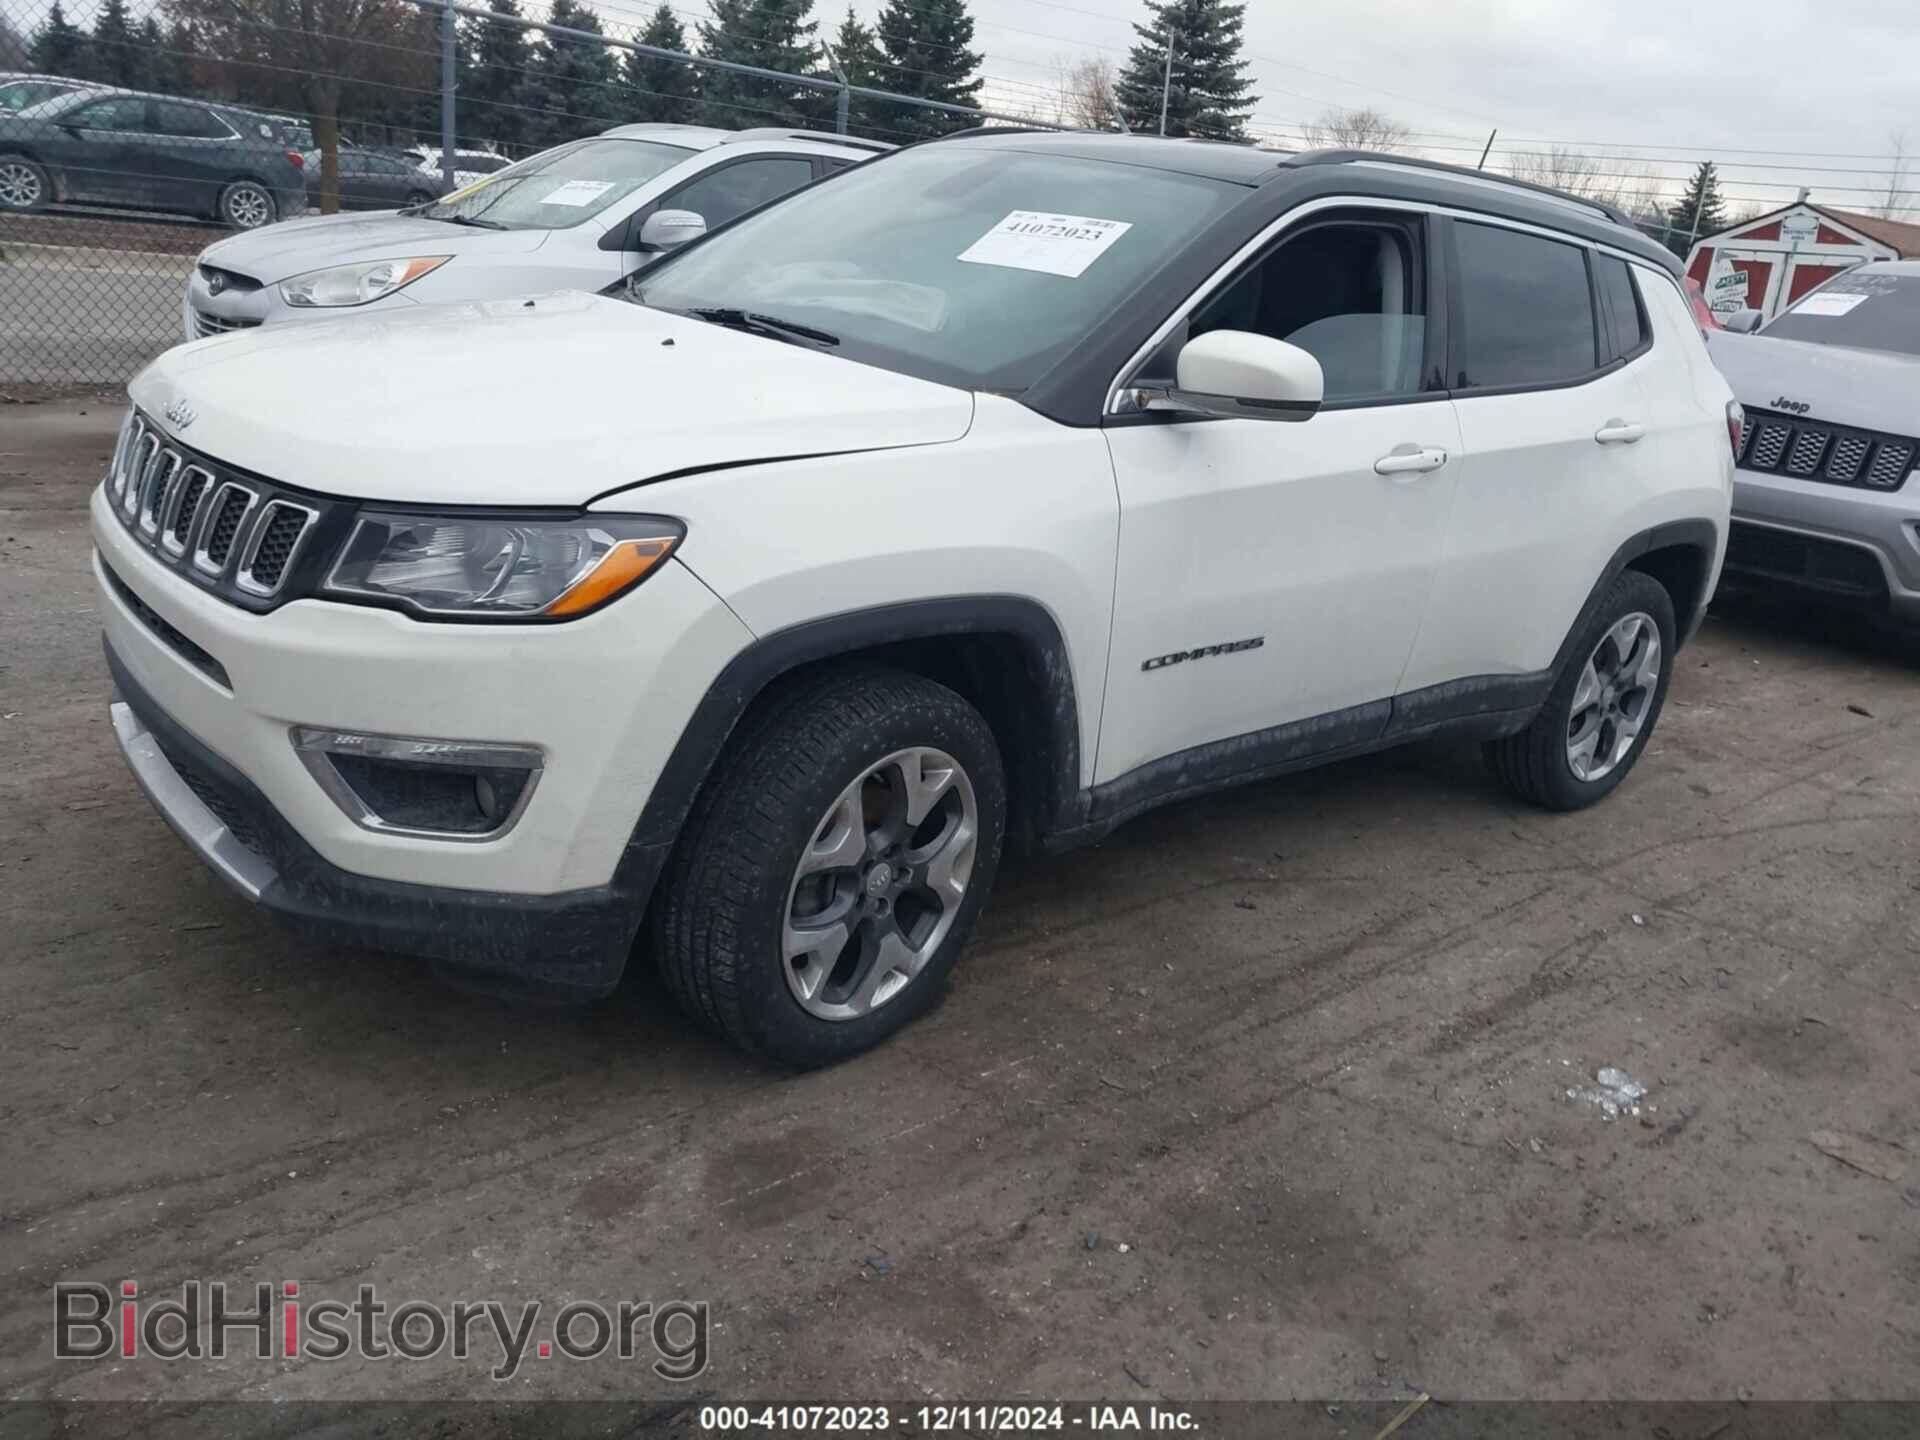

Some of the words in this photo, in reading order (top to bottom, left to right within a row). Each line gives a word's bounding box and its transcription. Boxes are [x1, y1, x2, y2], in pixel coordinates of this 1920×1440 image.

[1007, 222, 1103, 241] 41072023
[1770, 396, 1810, 413] Jeep
[1141, 637, 1265, 671] COMPASS
